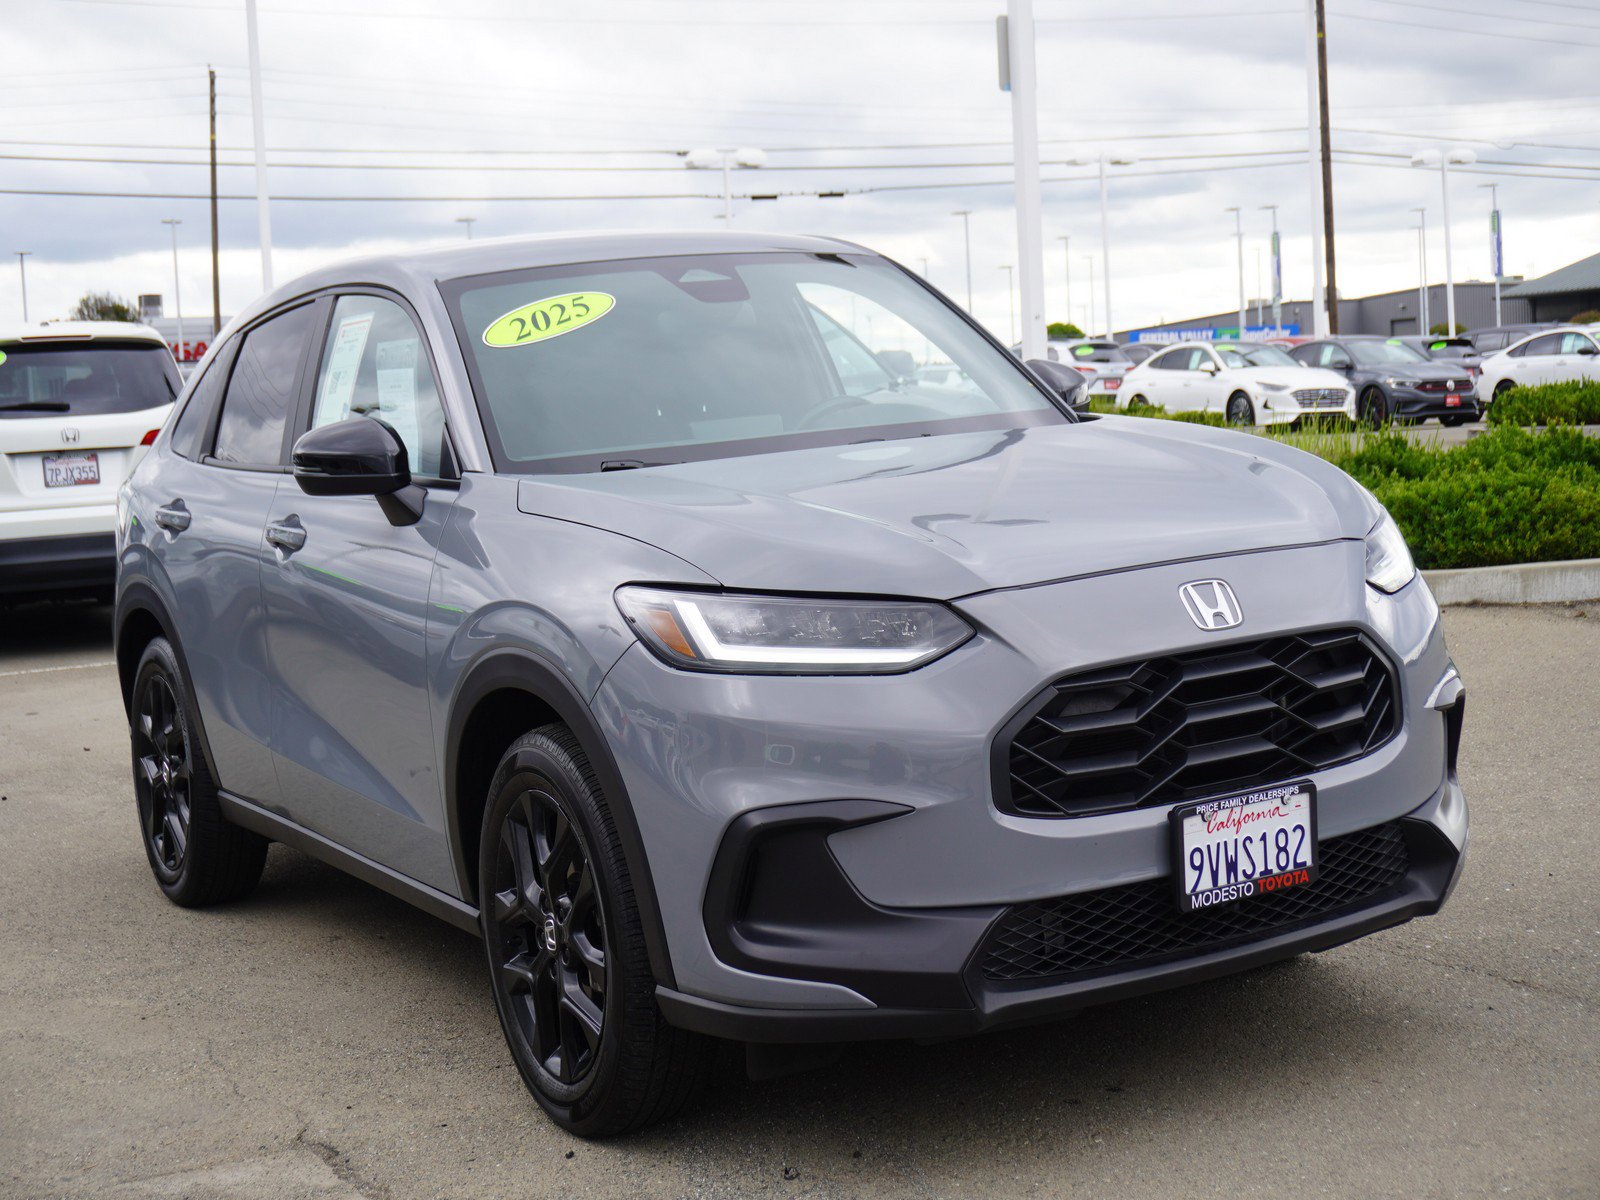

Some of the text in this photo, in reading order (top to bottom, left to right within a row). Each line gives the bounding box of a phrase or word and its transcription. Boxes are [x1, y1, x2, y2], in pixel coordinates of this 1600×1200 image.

[509, 296, 590, 341] 2025
[48, 465, 96, 484] 7PJX355
[1196, 785, 1300, 814] PRICE FAMILY DEALERSHIPS
[1206, 801, 1289, 835] California
[1189, 823, 1307, 894] 9VWS182
[1191, 869, 1309, 909] MODESTO TOYOTA
